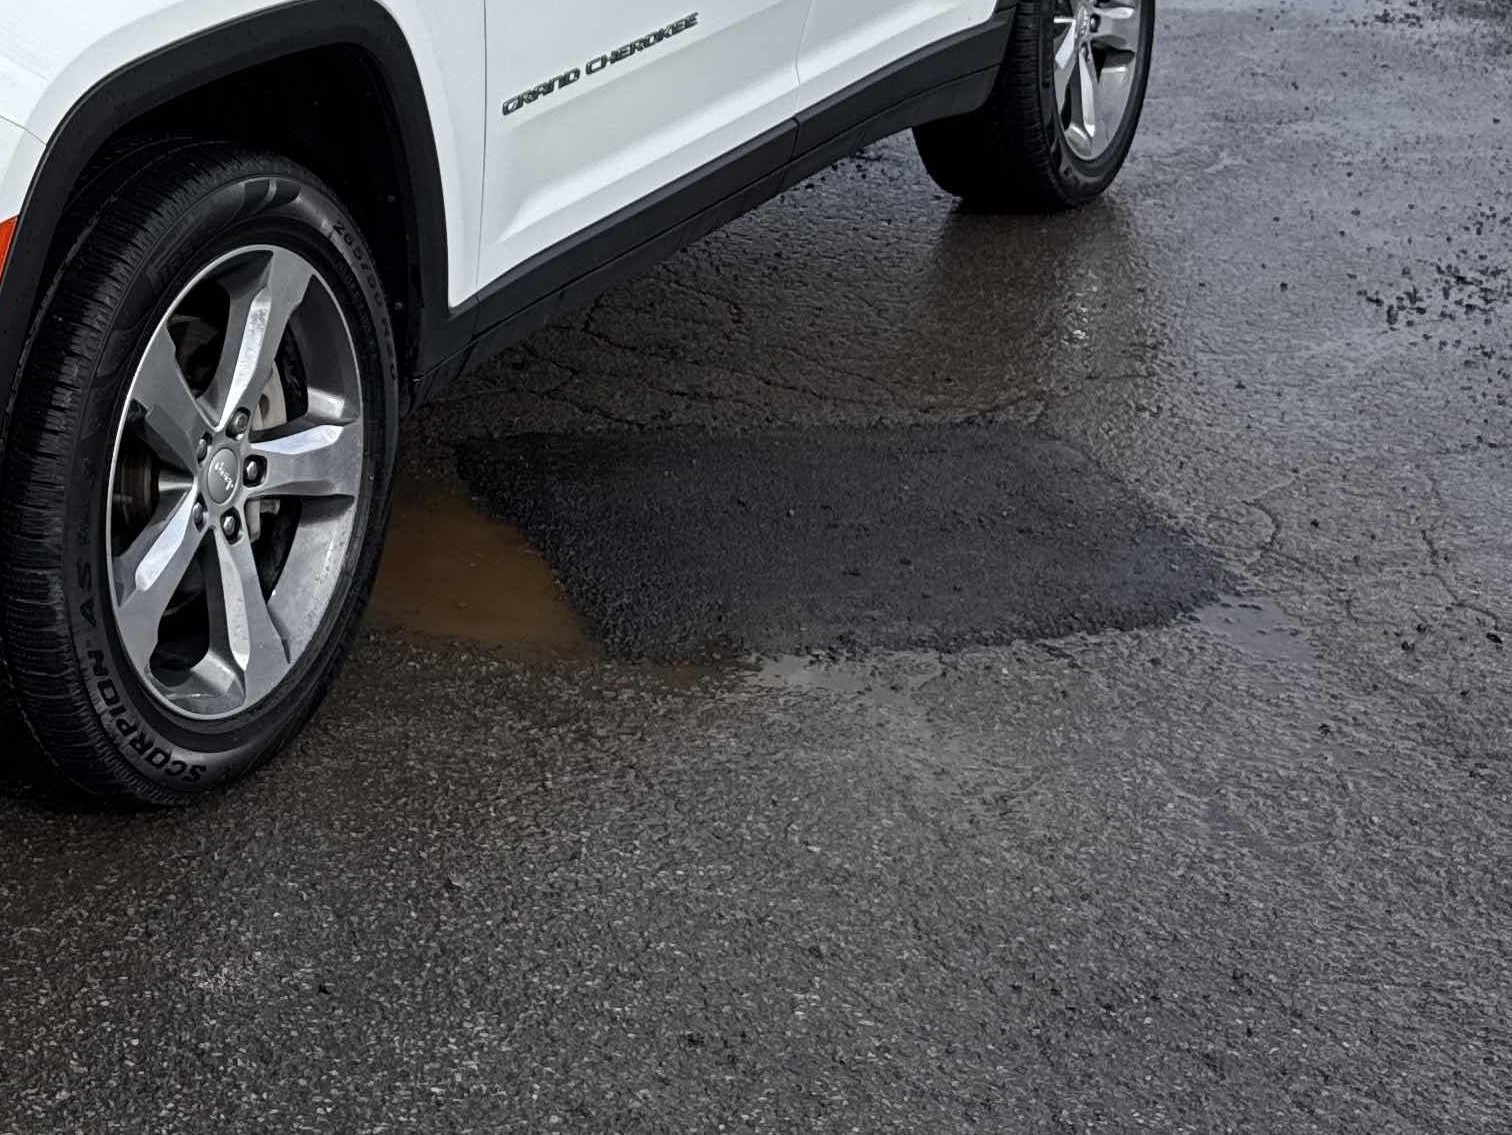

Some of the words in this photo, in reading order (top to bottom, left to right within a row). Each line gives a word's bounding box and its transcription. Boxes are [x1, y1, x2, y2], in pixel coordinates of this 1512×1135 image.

[502, 68, 581, 116] GRAND
[585, 11, 700, 76] CHEROKEE
[88, 648, 207, 784] SCORPION
